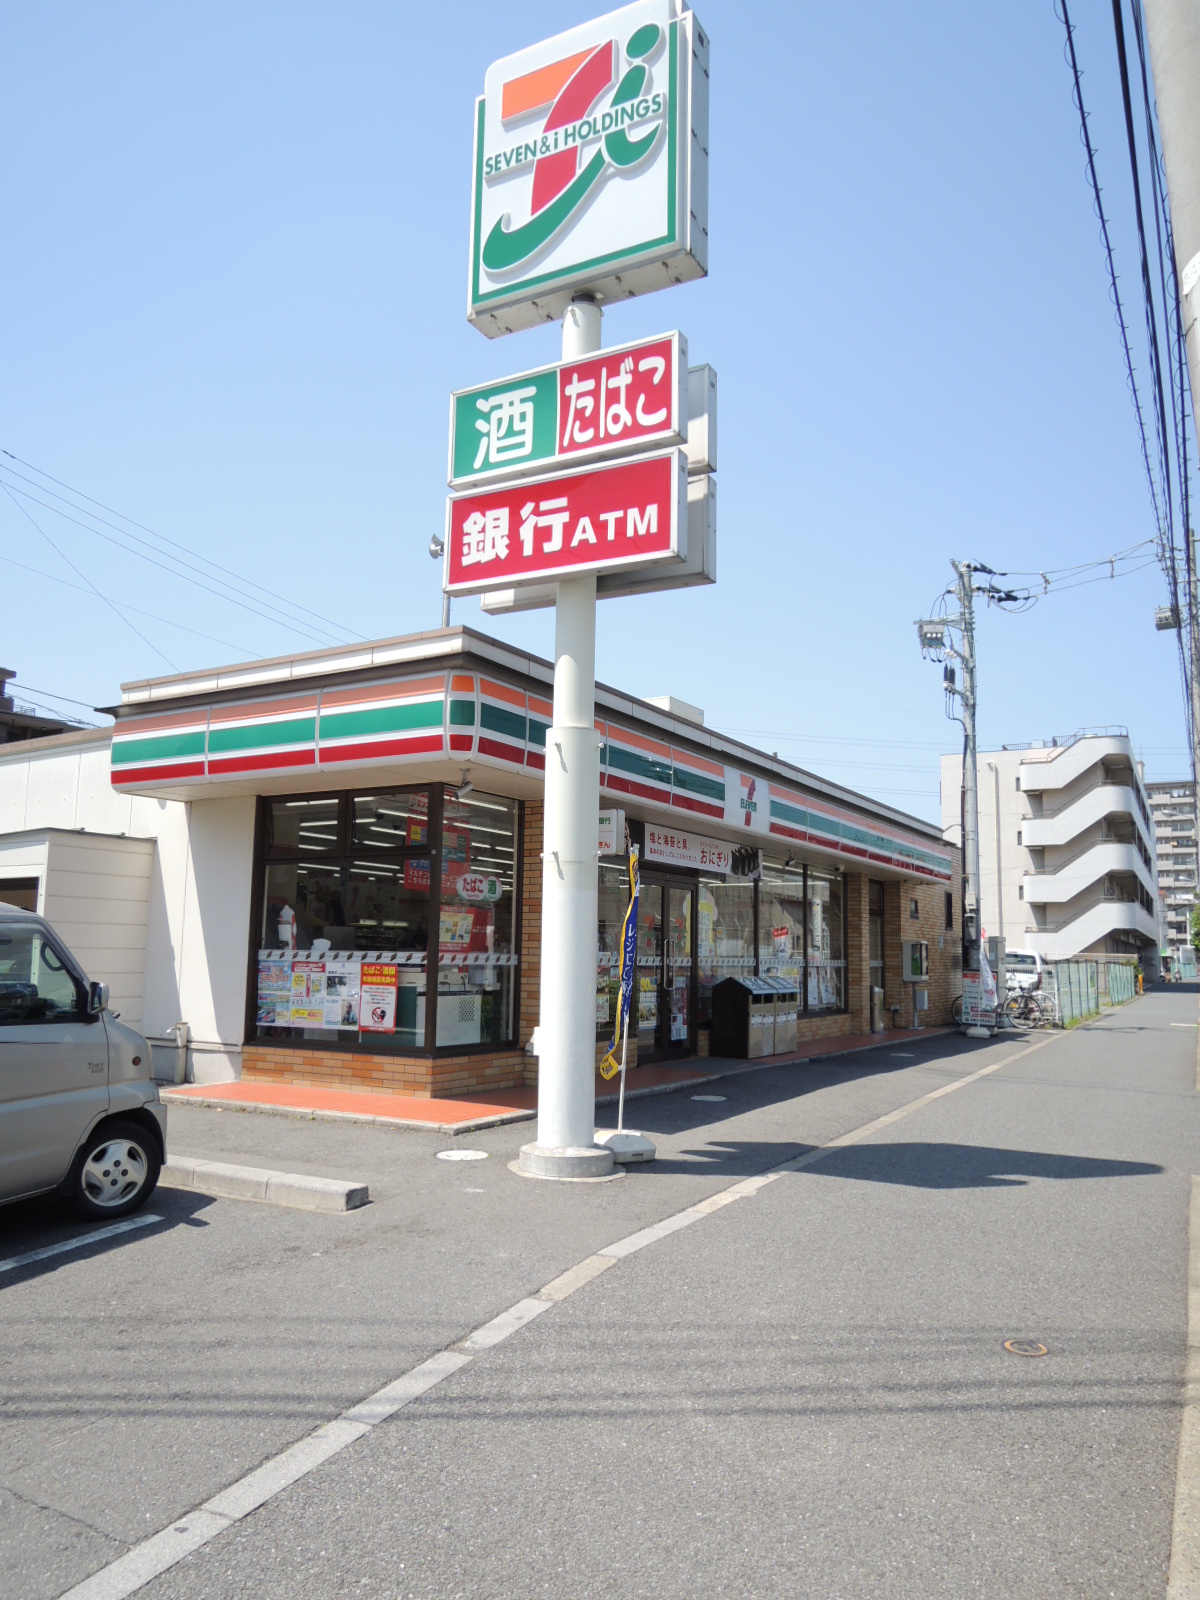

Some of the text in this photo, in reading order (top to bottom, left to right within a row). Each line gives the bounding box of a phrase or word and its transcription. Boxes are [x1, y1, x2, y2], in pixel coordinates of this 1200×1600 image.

[563, 93, 663, 148] HOLDINGS
[562, 355, 668, 448] たばこ
[473, 385, 537, 470] 酒
[700, 848, 729, 868] おにぎり
[462, 877, 484, 893] たばこ
[488, 879, 497, 895] 酒
